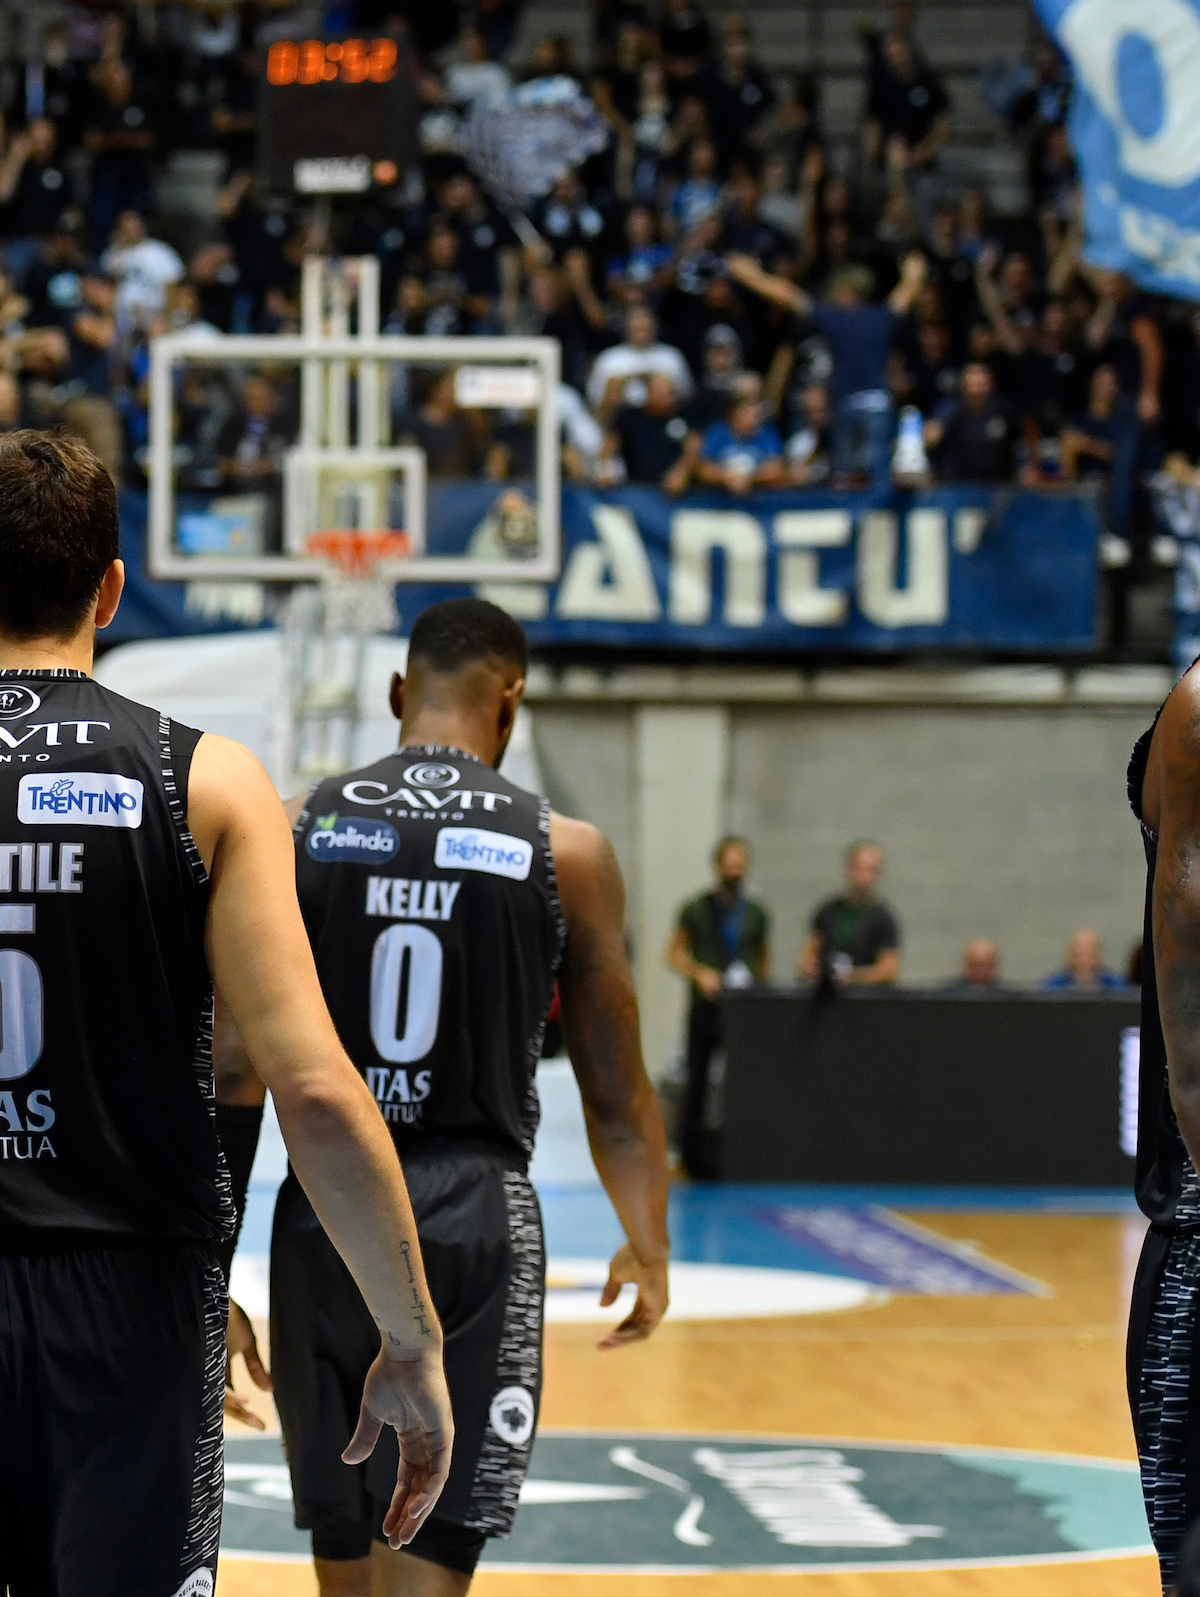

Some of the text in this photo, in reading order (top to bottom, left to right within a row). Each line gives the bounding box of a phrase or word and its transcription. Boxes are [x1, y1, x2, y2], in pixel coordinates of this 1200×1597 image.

[27, 786, 137, 815] TRENTINO
[342, 780, 512, 813] CAVIT
[385, 807, 465, 820] TRENTO
[365, 876, 461, 921] KELLY
[369, 922, 443, 1064] 0
